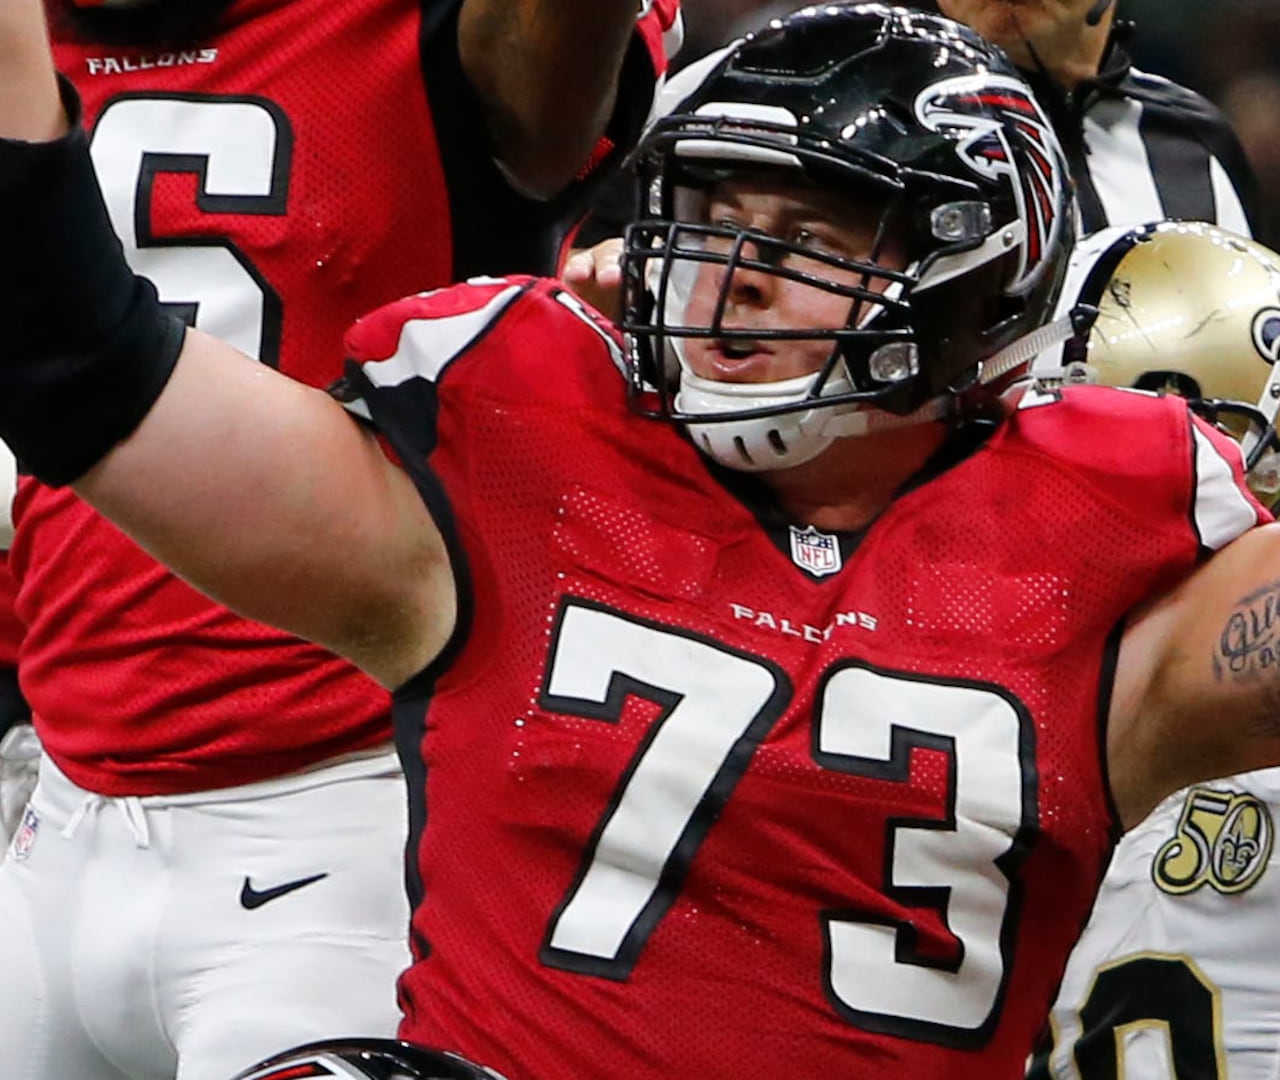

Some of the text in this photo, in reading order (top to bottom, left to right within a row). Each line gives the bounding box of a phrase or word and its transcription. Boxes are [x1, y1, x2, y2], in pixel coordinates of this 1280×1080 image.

[798, 545, 834, 568] NFL
[540, 594, 1041, 1052] 73
[1152, 786, 1274, 895] 50
